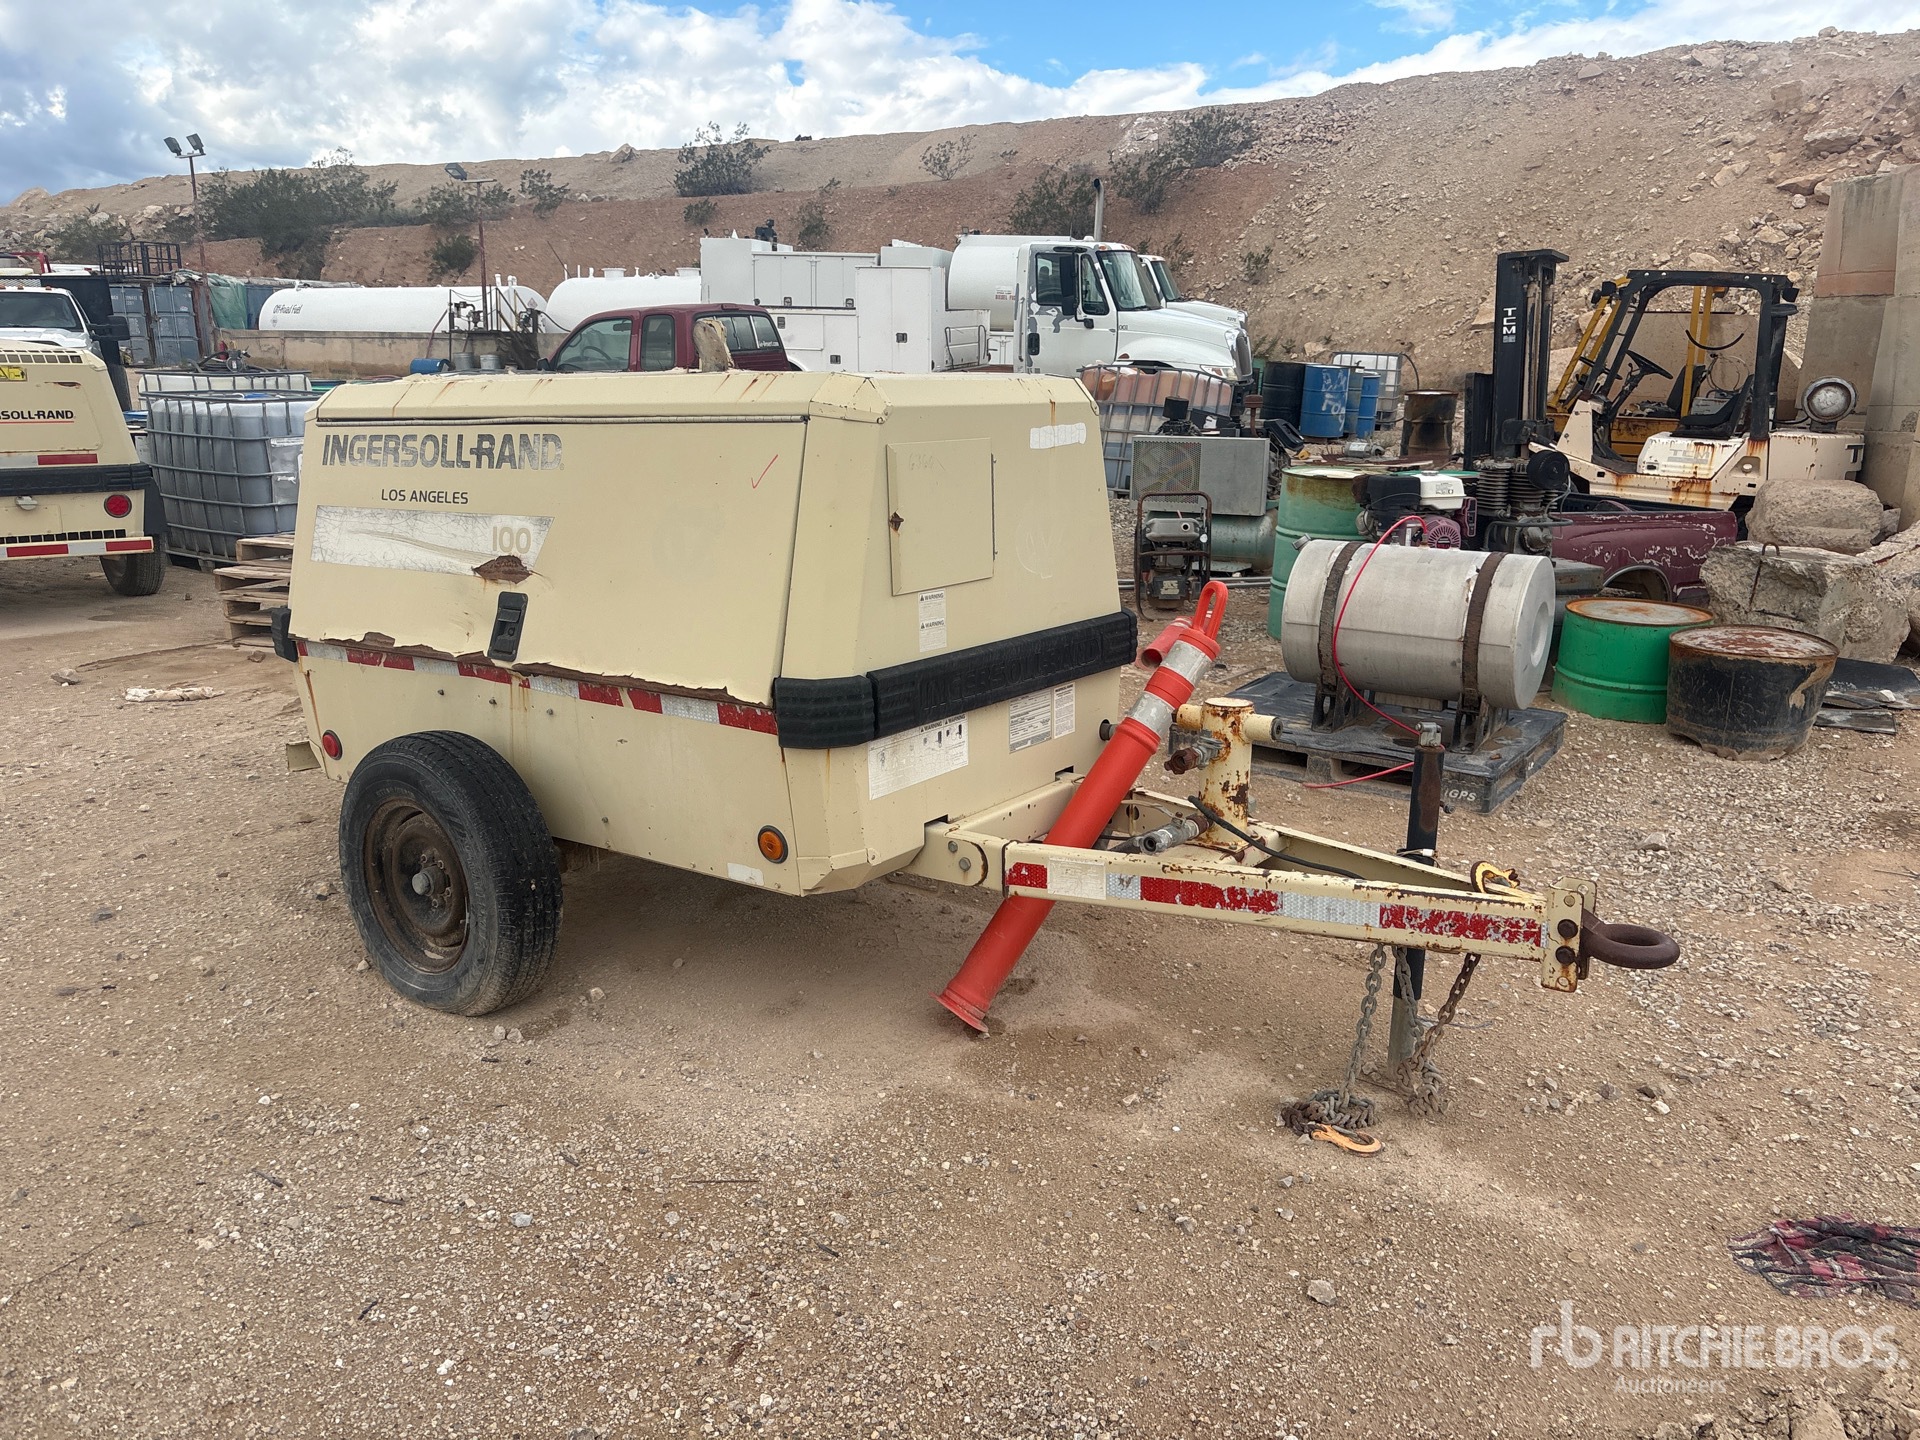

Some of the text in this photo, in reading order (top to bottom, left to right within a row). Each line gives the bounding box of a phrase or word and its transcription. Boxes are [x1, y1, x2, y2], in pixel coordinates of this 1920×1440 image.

[1502, 307, 1517, 335] TCM
[0, 410, 74, 420] SOLL-RAND
[322, 433, 563, 471] INGERSOLL-RAND
[381, 488, 469, 505] LOS ANGELES
[492, 526, 532, 555] 100
[924, 592, 944, 601] WARNING
[924, 619, 945, 628] WARNING
